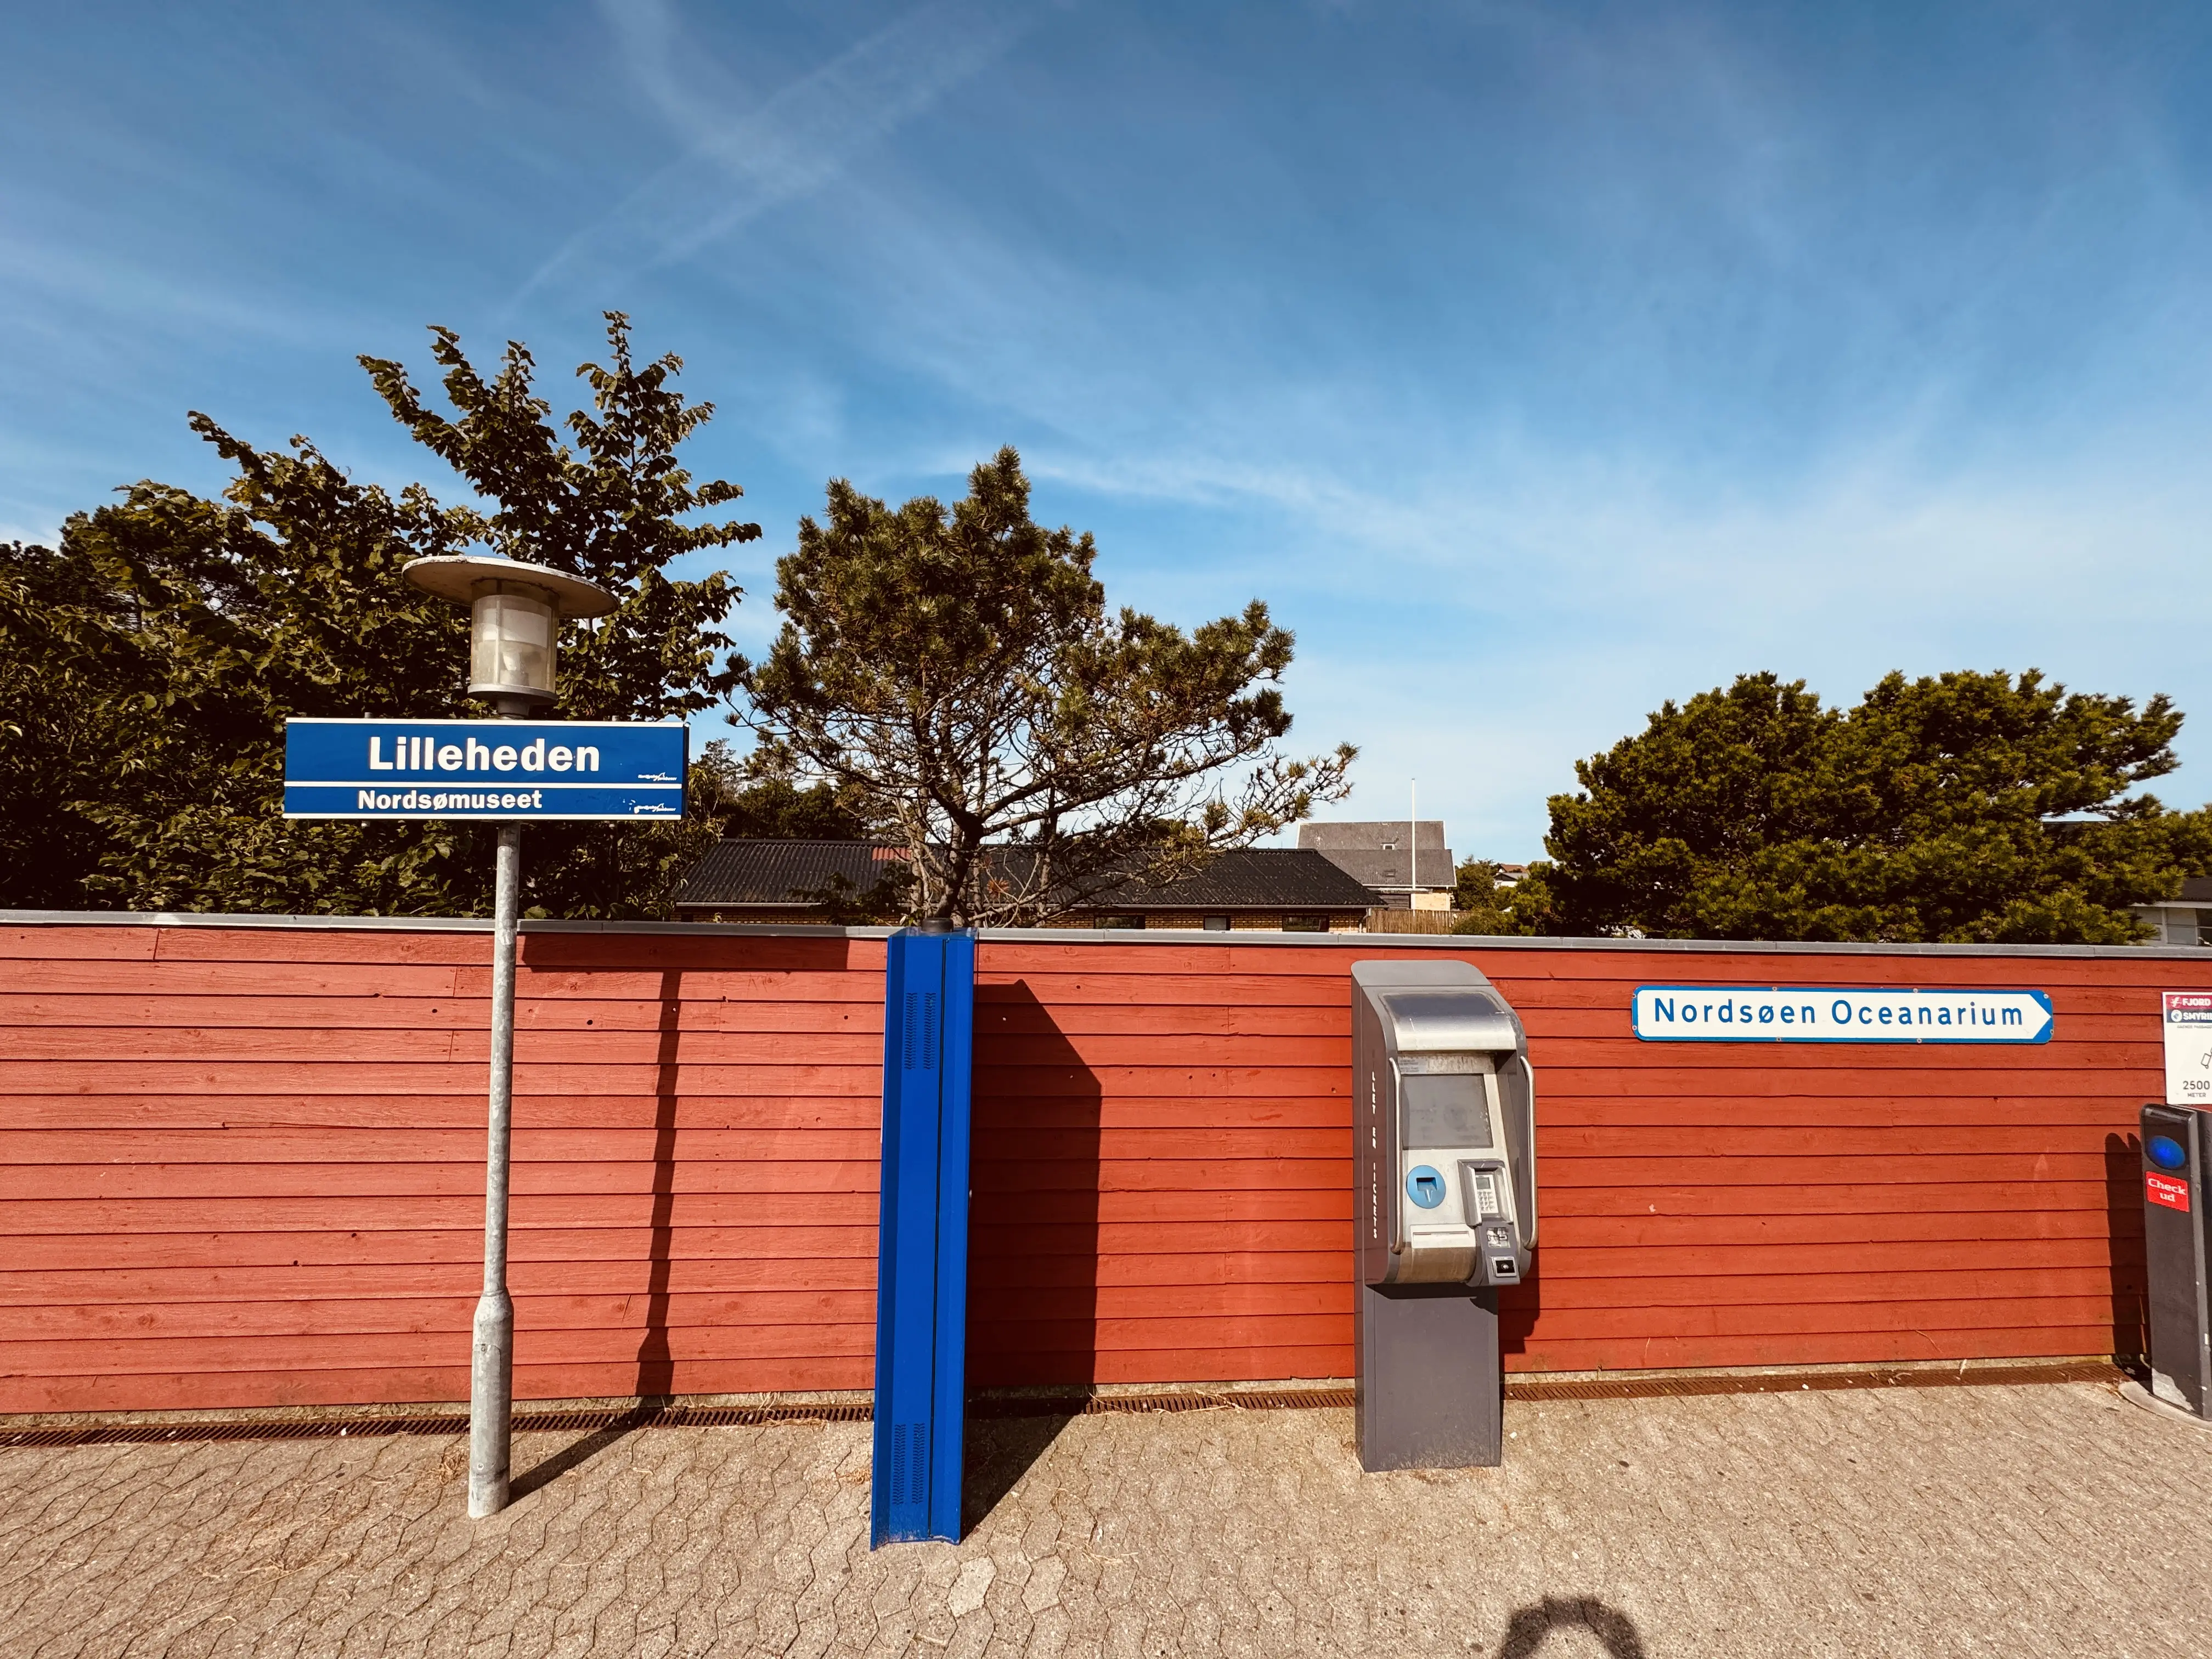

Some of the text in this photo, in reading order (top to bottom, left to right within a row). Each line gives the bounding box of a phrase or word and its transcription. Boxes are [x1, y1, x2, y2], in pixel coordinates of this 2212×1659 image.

[369, 736, 600, 771] Lilleheden
[358, 789, 542, 810] Nordsømuseet
[2182, 998, 2211, 1006] FJORD
[1655, 998, 2022, 1025] Nordsøen Oceanarium
[2182, 1080, 2210, 1090] 2500
[2148, 1178, 2187, 1195] Check
[2159, 1192, 2176, 1203] ud
